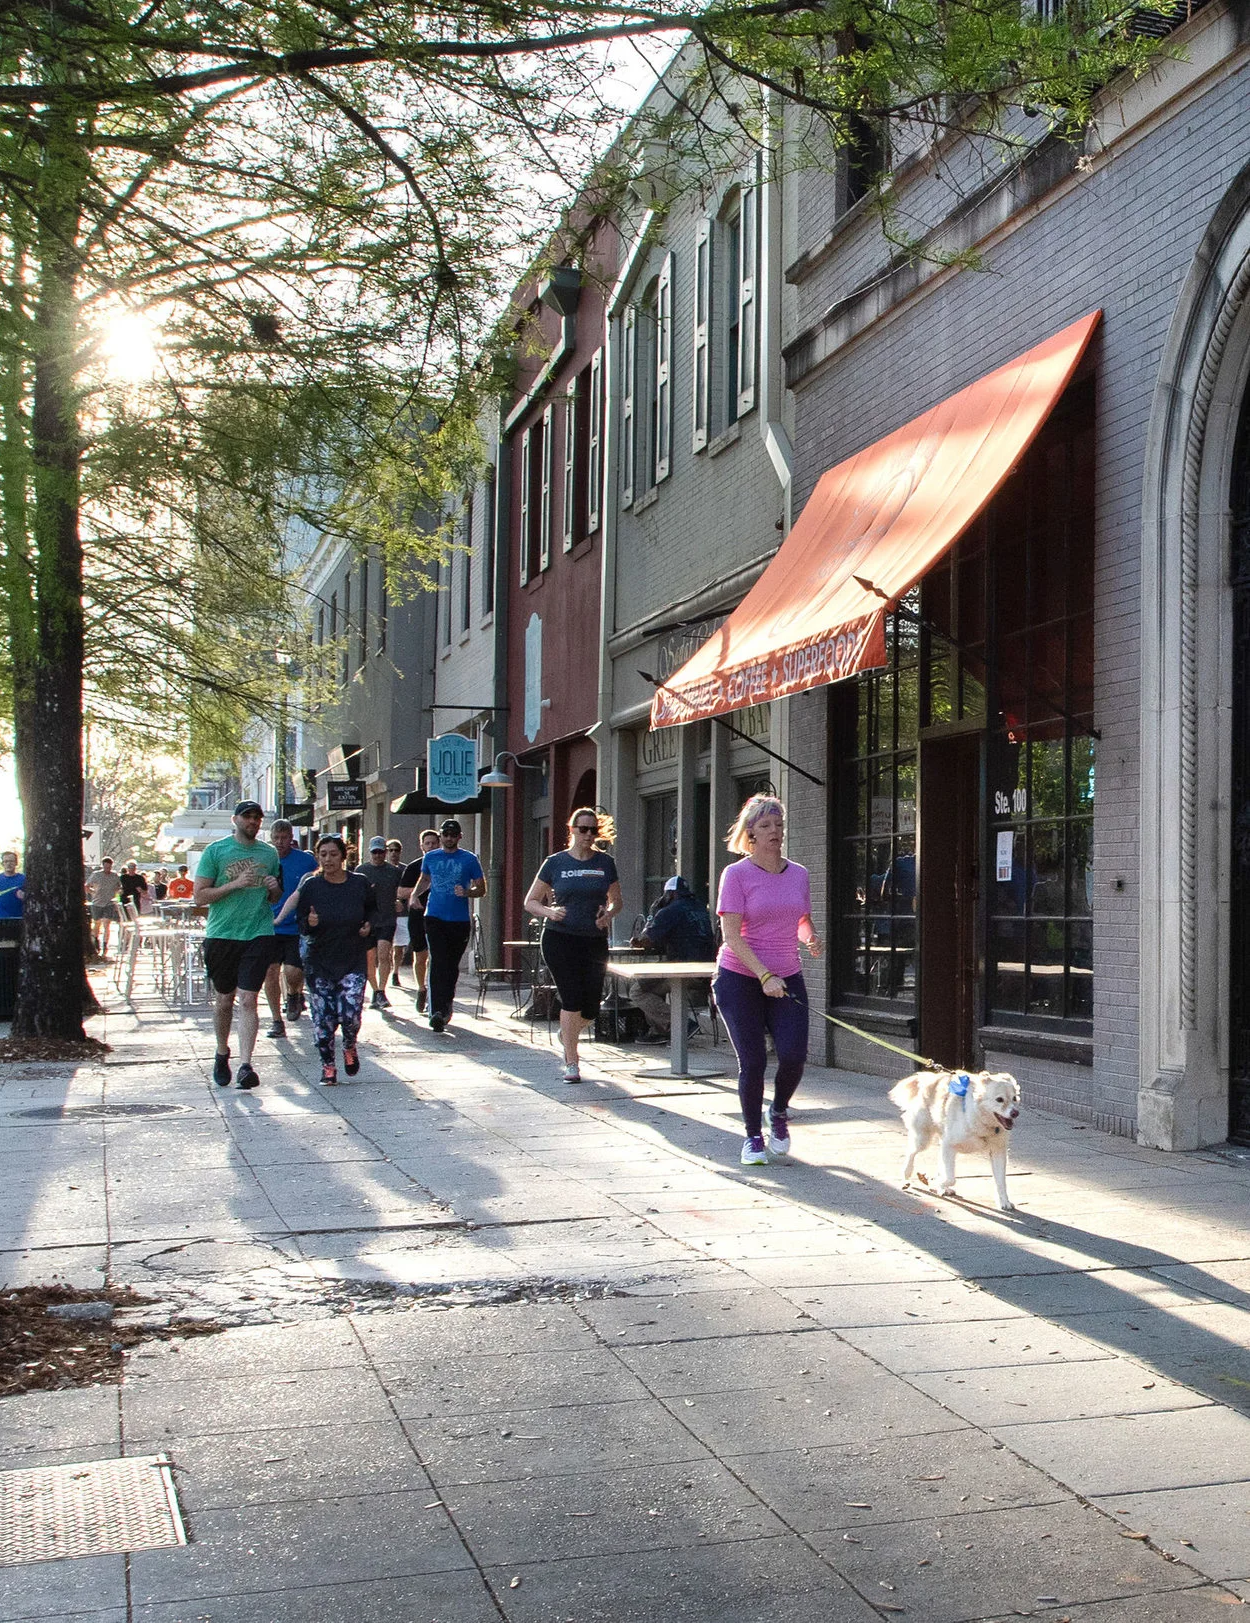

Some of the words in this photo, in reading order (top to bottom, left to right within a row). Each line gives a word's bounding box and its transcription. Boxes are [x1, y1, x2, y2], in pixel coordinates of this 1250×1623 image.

[727, 662, 768, 702] COFFEE
[643, 725, 680, 765] GREE
[432, 750, 473, 776] JOLIE
[438, 776, 469, 787] PEARL
[994, 790, 1011, 815] Ste.
[1012, 788, 1027, 813] 100
